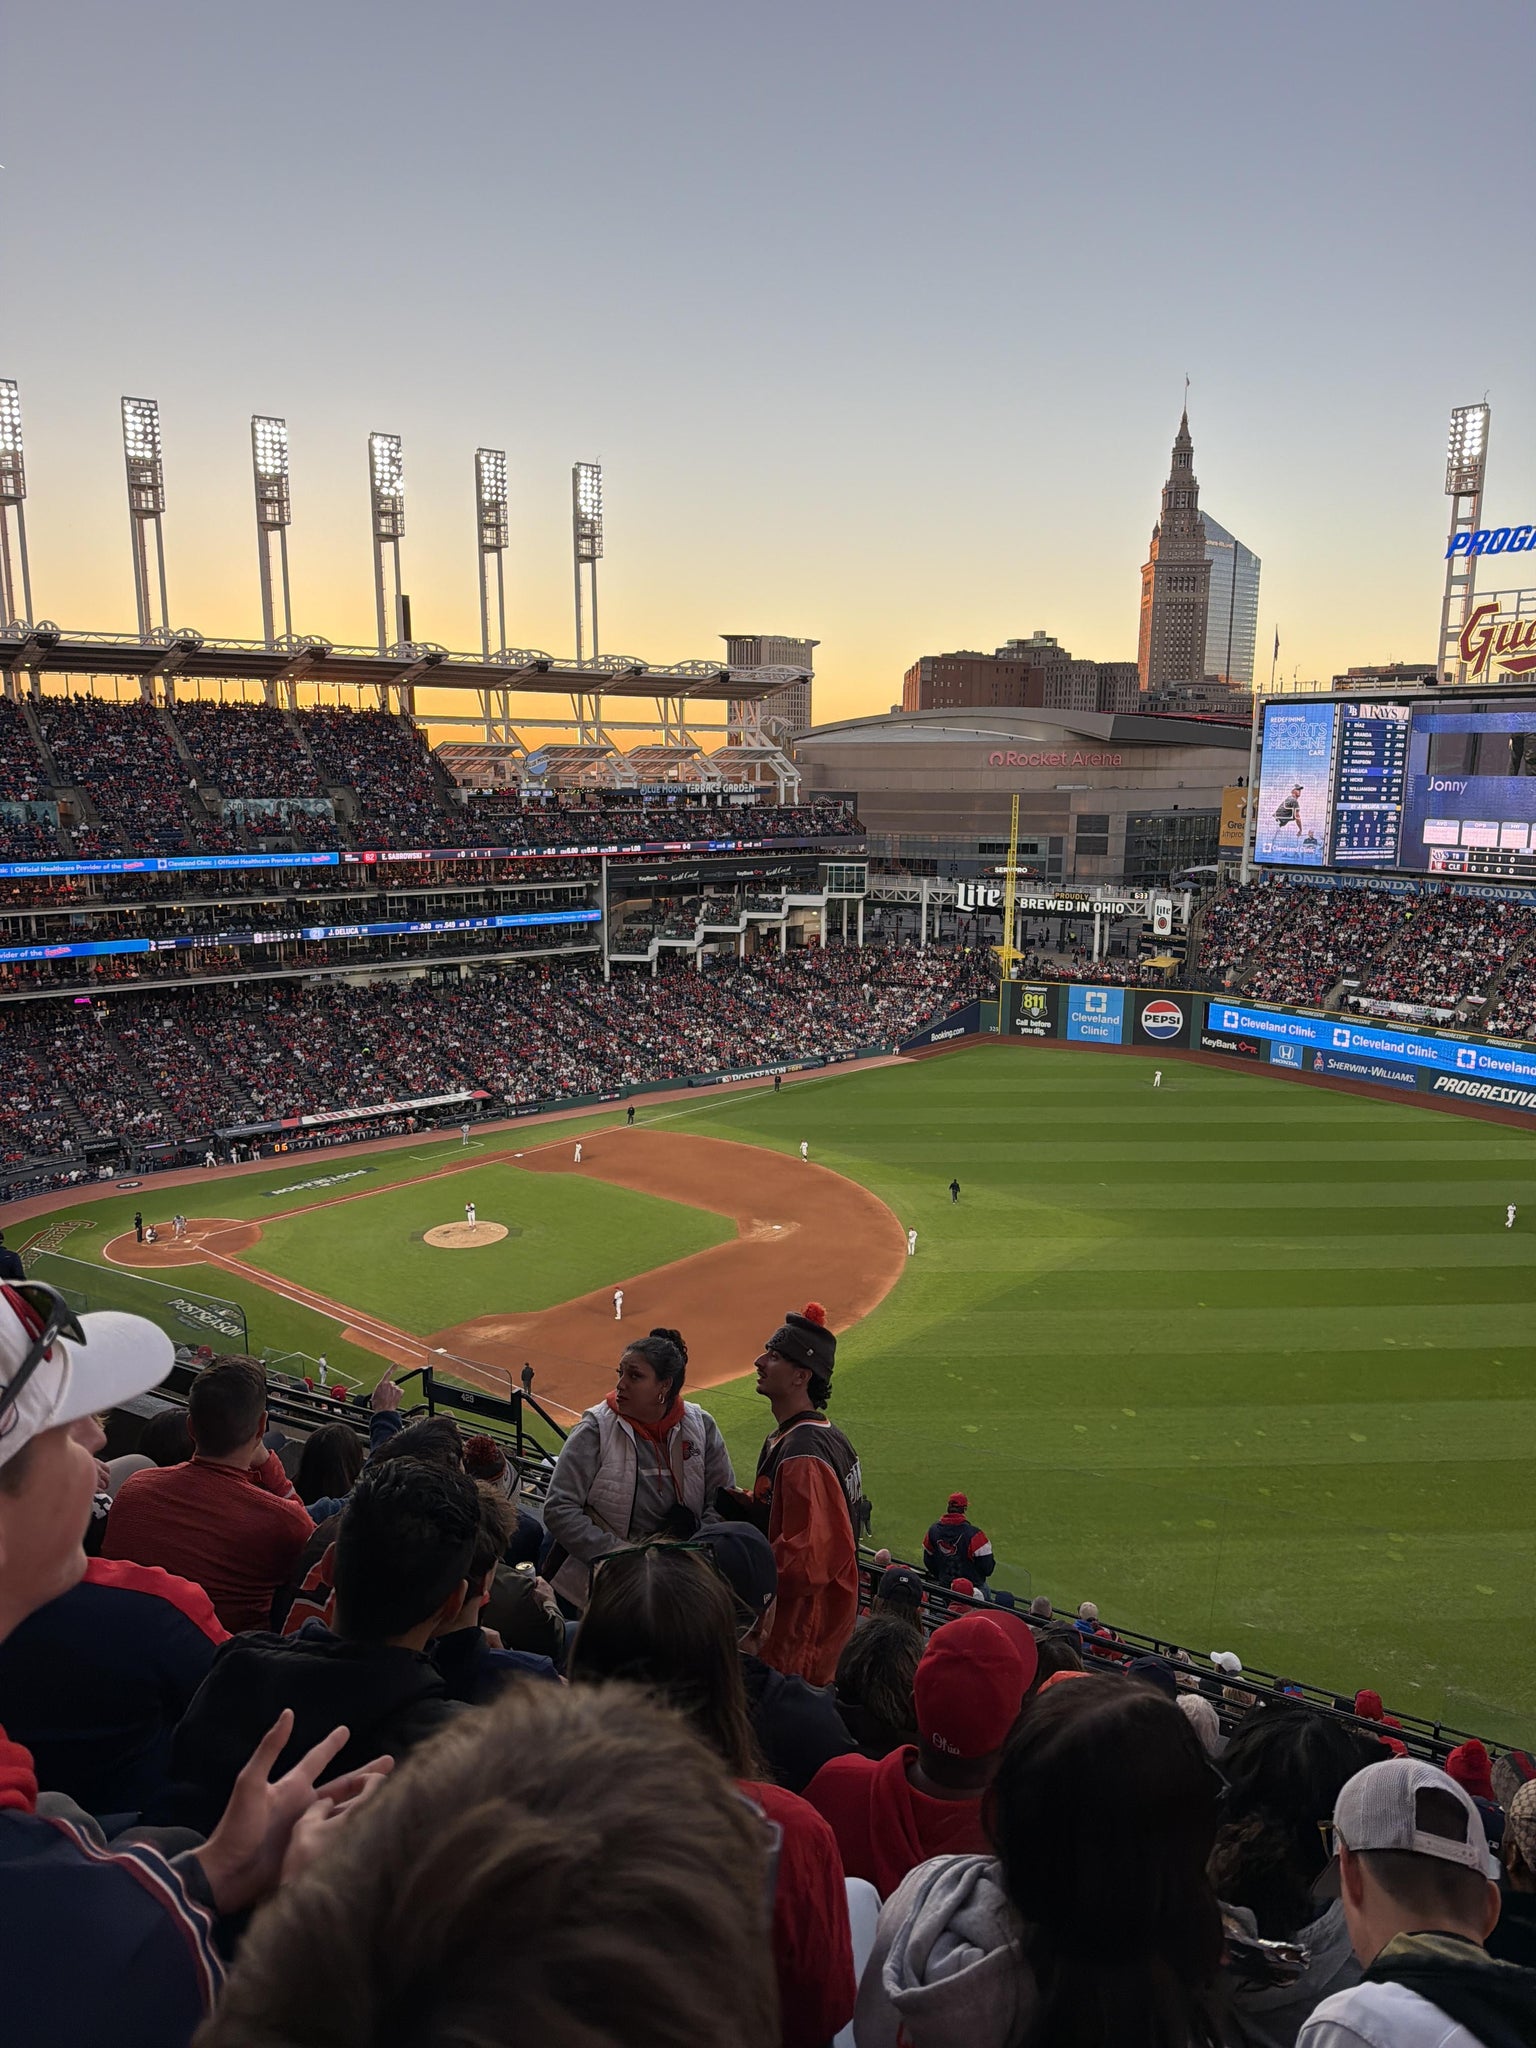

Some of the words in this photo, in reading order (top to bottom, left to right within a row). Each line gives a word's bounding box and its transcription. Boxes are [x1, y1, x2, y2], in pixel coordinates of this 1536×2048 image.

[1445, 525, 1536, 559] PROG
[1370, 706, 1397, 719] RAYS
[1270, 722, 1328, 738] SPORTS
[1268, 736, 1326, 750] MEDICINE
[1006, 751, 1066, 766] Rocket
[1071, 752, 1122, 766] Arena
[640, 784, 660, 795] BLUE
[662, 784, 682, 793] MOON
[686, 784, 720, 793] TERRACE
[723, 784, 754, 792] GARDEN
[1427, 776, 1468, 795] Jonny
[1356, 878, 1416, 891] HONDA
[955, 882, 1000, 912] Lite
[1467, 886, 1536, 900] HONDA
[1020, 898, 1073, 911] BREWED
[1076, 902, 1089, 912] IN
[1093, 902, 1124, 914] OHIO
[1157, 905, 1170, 916] Lite
[1024, 993, 1044, 1009] 811
[1072, 1012, 1120, 1025] Cleveland
[1144, 1014, 1180, 1024] PEPSI
[1295, 1009, 1326, 1018] PROGRESSIVE
[1340, 1016, 1371, 1025] PROGRESSIVE
[1034, 1028, 1045, 1036] dig.
[1080, 1025, 1109, 1036] Clinic
[1240, 1016, 1286, 1034] Cleveland
[1288, 1024, 1316, 1038] Clinic
[1386, 1023, 1420, 1033] PROGRESSIVE
[931, 1027, 964, 1042] Booking.com
[1435, 1030, 1470, 1041] PROGRESSIVE
[1202, 1036, 1237, 1050] KeyBank
[1352, 1034, 1404, 1054] Cleveland
[1407, 1044, 1438, 1059] Clinic
[1486, 1038, 1524, 1049] PROGRESSIVE
[1272, 1058, 1299, 1067] HONDA
[732, 1067, 786, 1081] POSTSEASON
[1433, 1076, 1536, 1108] PROGRESSIVE
[312, 1101, 412, 1122] CLEVELAND
[84, 1141, 118, 1150] Booking.com
[168, 1298, 245, 1338] POSTSEASON
[461, 1393, 474, 1403] 429
